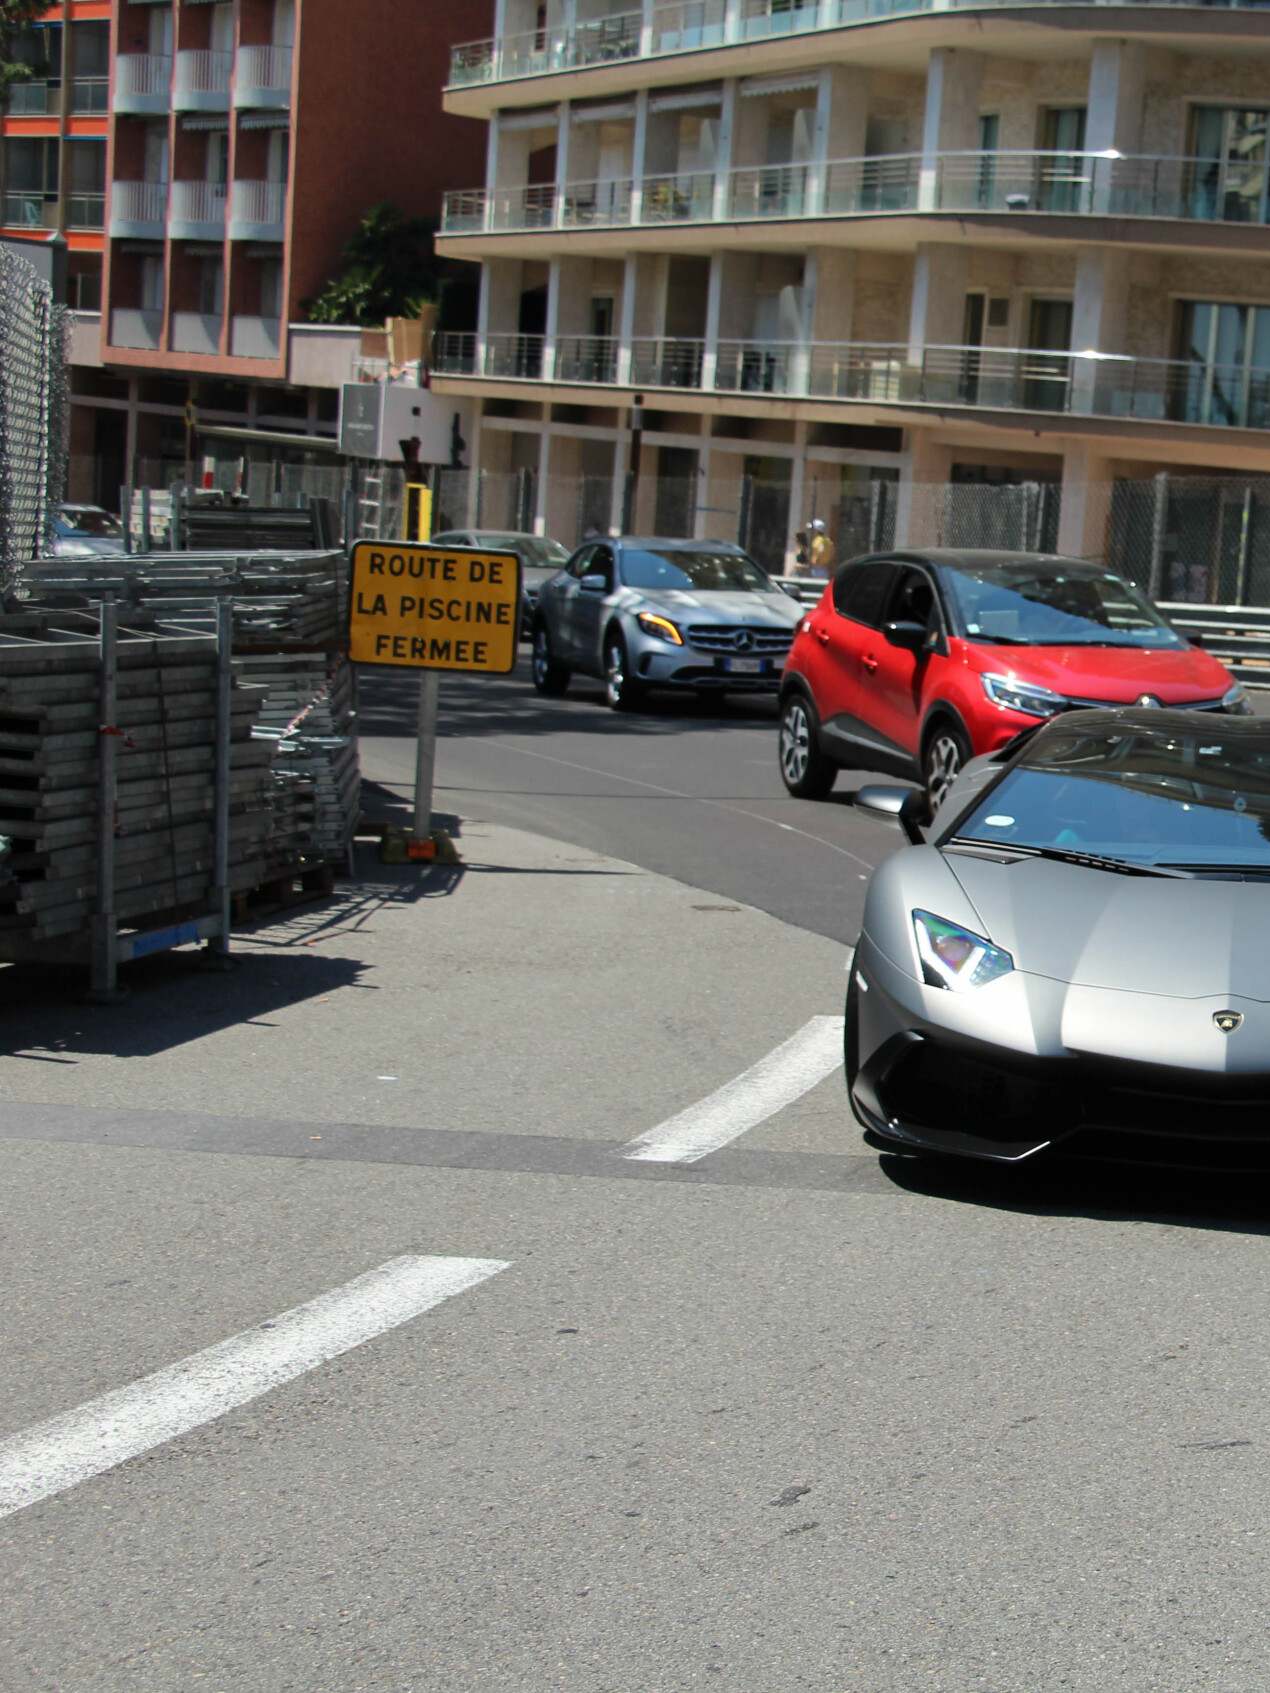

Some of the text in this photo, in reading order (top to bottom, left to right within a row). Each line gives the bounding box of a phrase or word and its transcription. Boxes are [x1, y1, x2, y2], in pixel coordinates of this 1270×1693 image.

[369, 553, 504, 584] ROUTE DE
[357, 592, 511, 625] LA PISCINE
[376, 634, 488, 664] FERMEE
